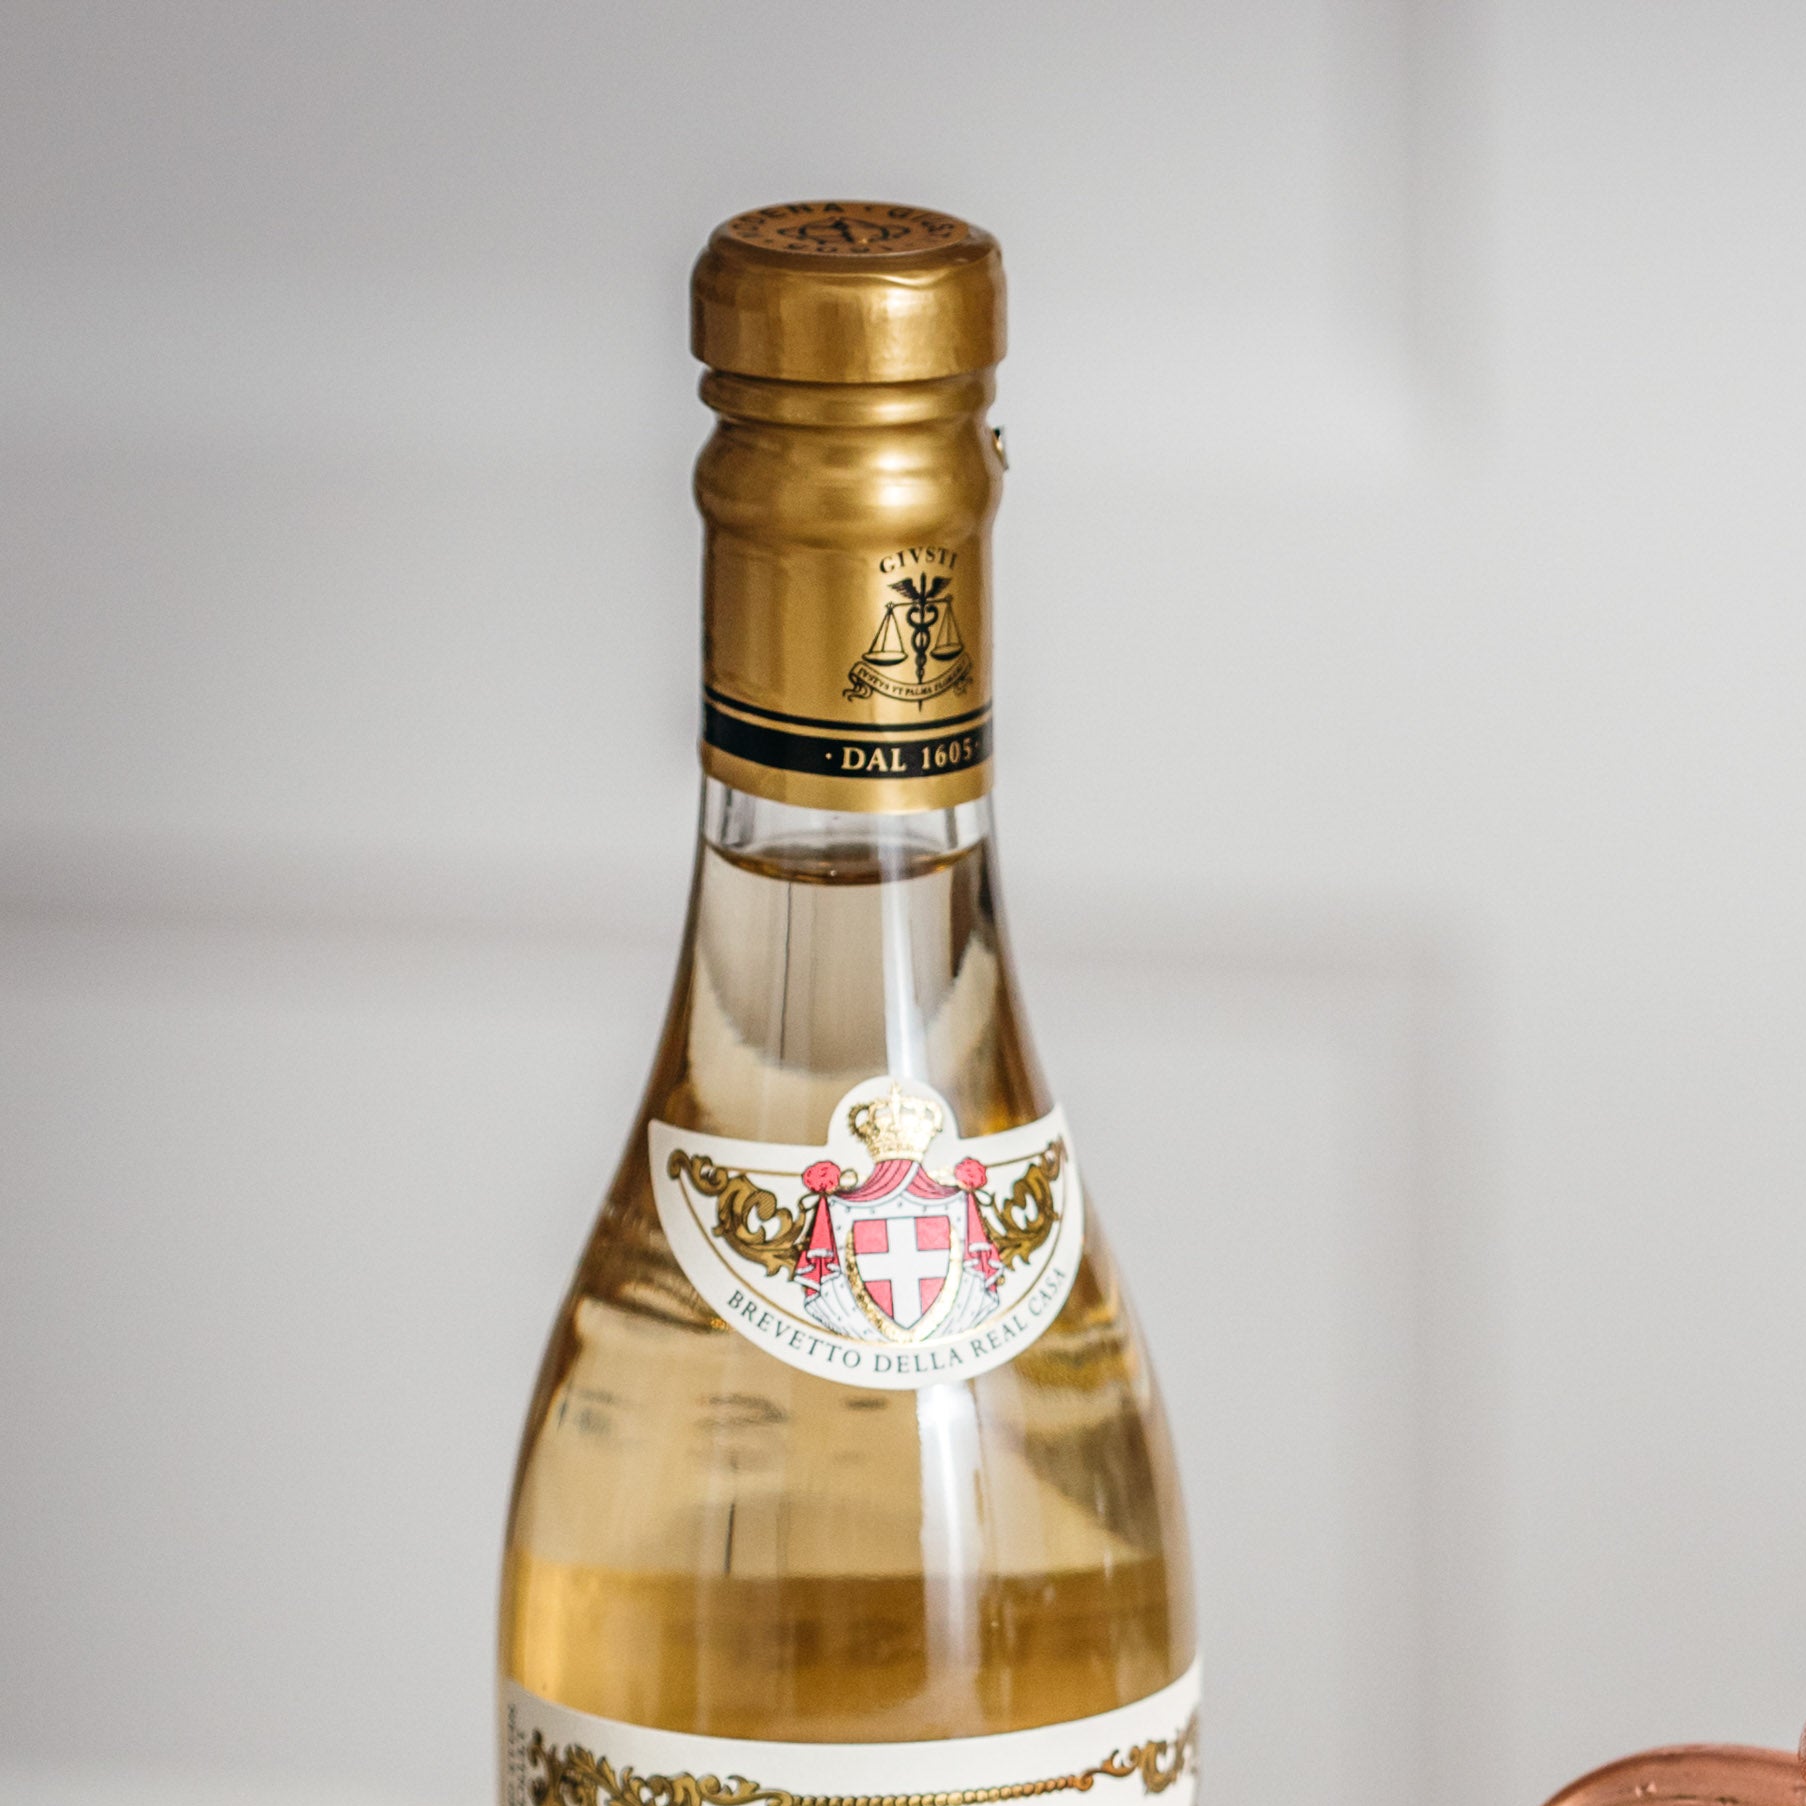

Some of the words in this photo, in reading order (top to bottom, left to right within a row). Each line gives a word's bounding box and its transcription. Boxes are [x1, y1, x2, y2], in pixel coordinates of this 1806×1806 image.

[879, 545, 958, 574] GIVSTI
[841, 746, 906, 772] DAL
[921, 737, 972, 770] 1605
[726, 1289, 861, 1369] BREVETTO
[873, 1347, 964, 1375] DELLA
[972, 1320, 1028, 1358] REAL
[1031, 1266, 1067, 1317] CASA
